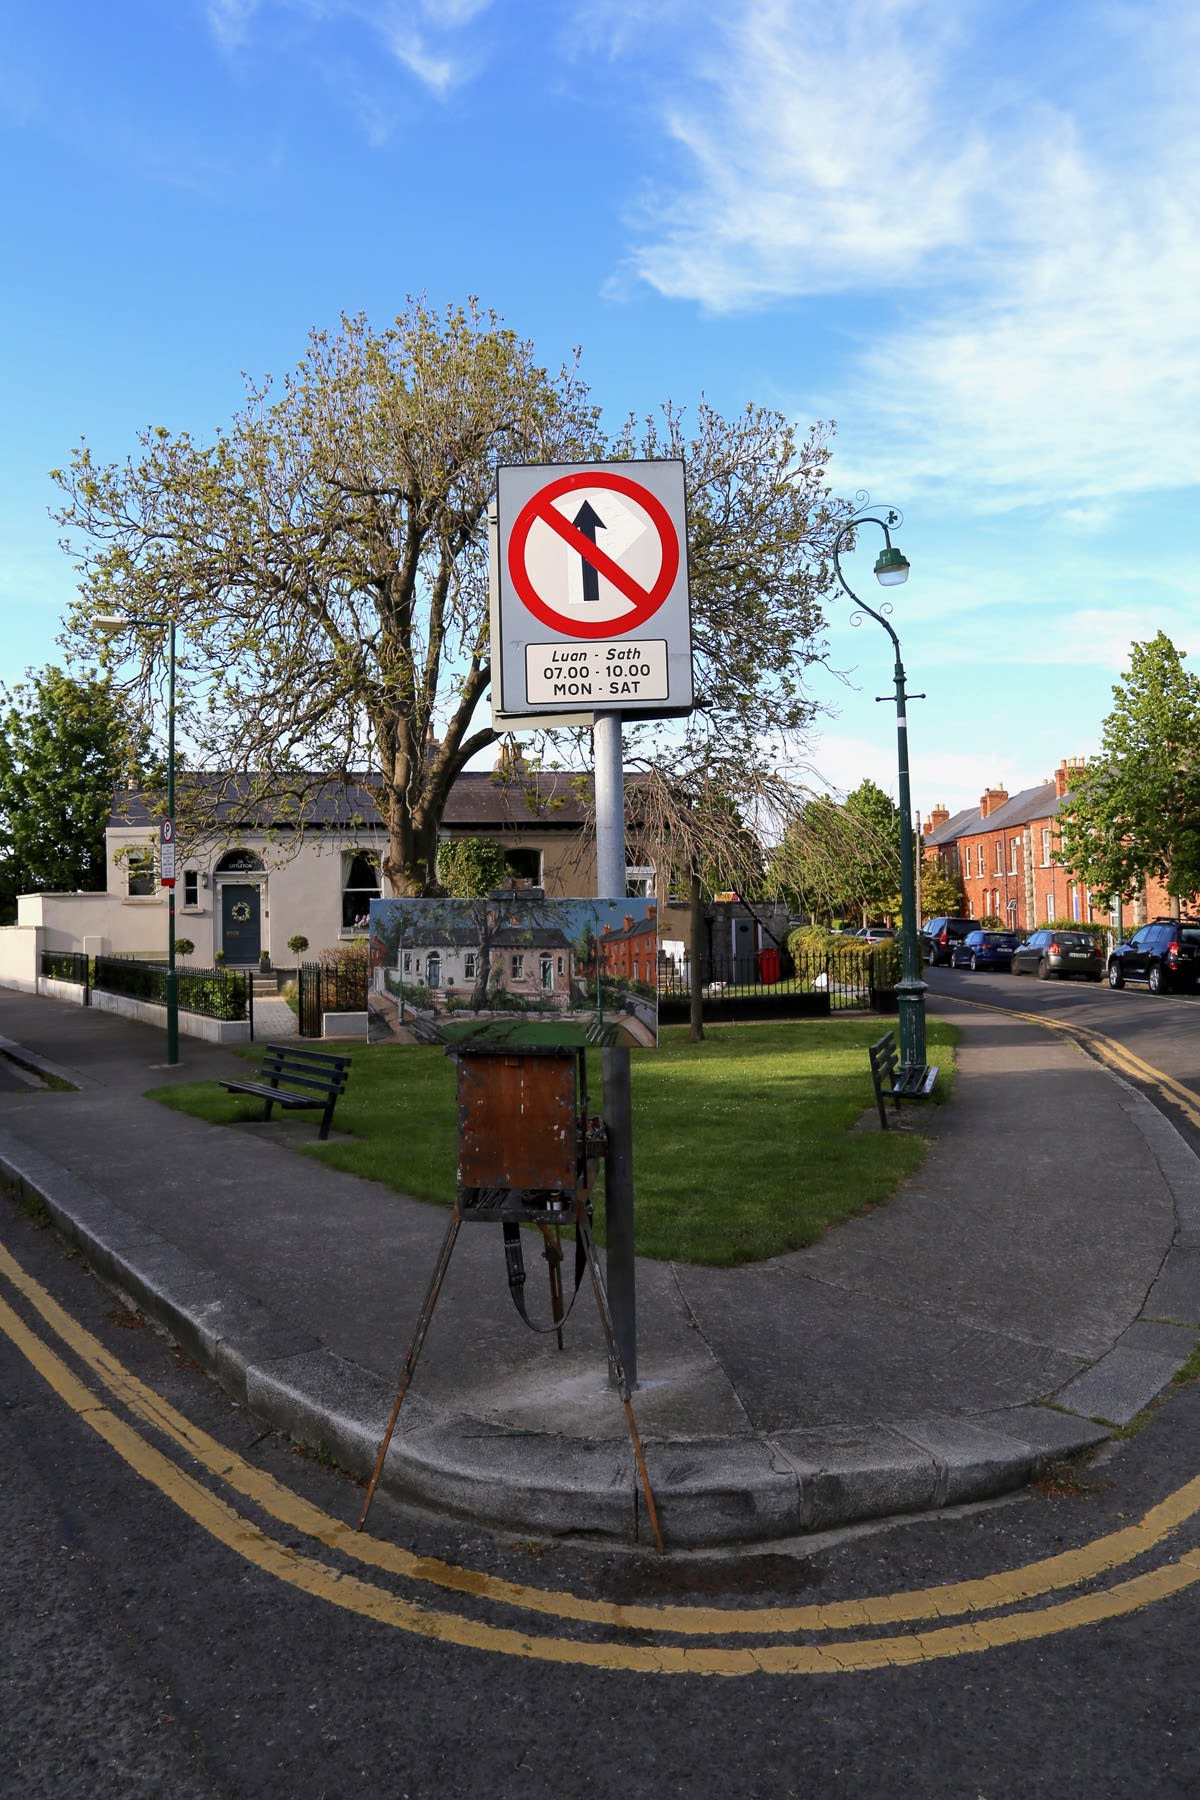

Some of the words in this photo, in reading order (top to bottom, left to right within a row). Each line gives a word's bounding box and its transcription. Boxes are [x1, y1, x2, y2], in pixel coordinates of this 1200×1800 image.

[552, 650, 588, 662] Luan
[606, 648, 641, 660] Sath
[543, 666, 590, 680] 07.00
[606, 664, 651, 678] 10.00
[553, 683, 592, 696] MON
[609, 681, 641, 694] SAT
